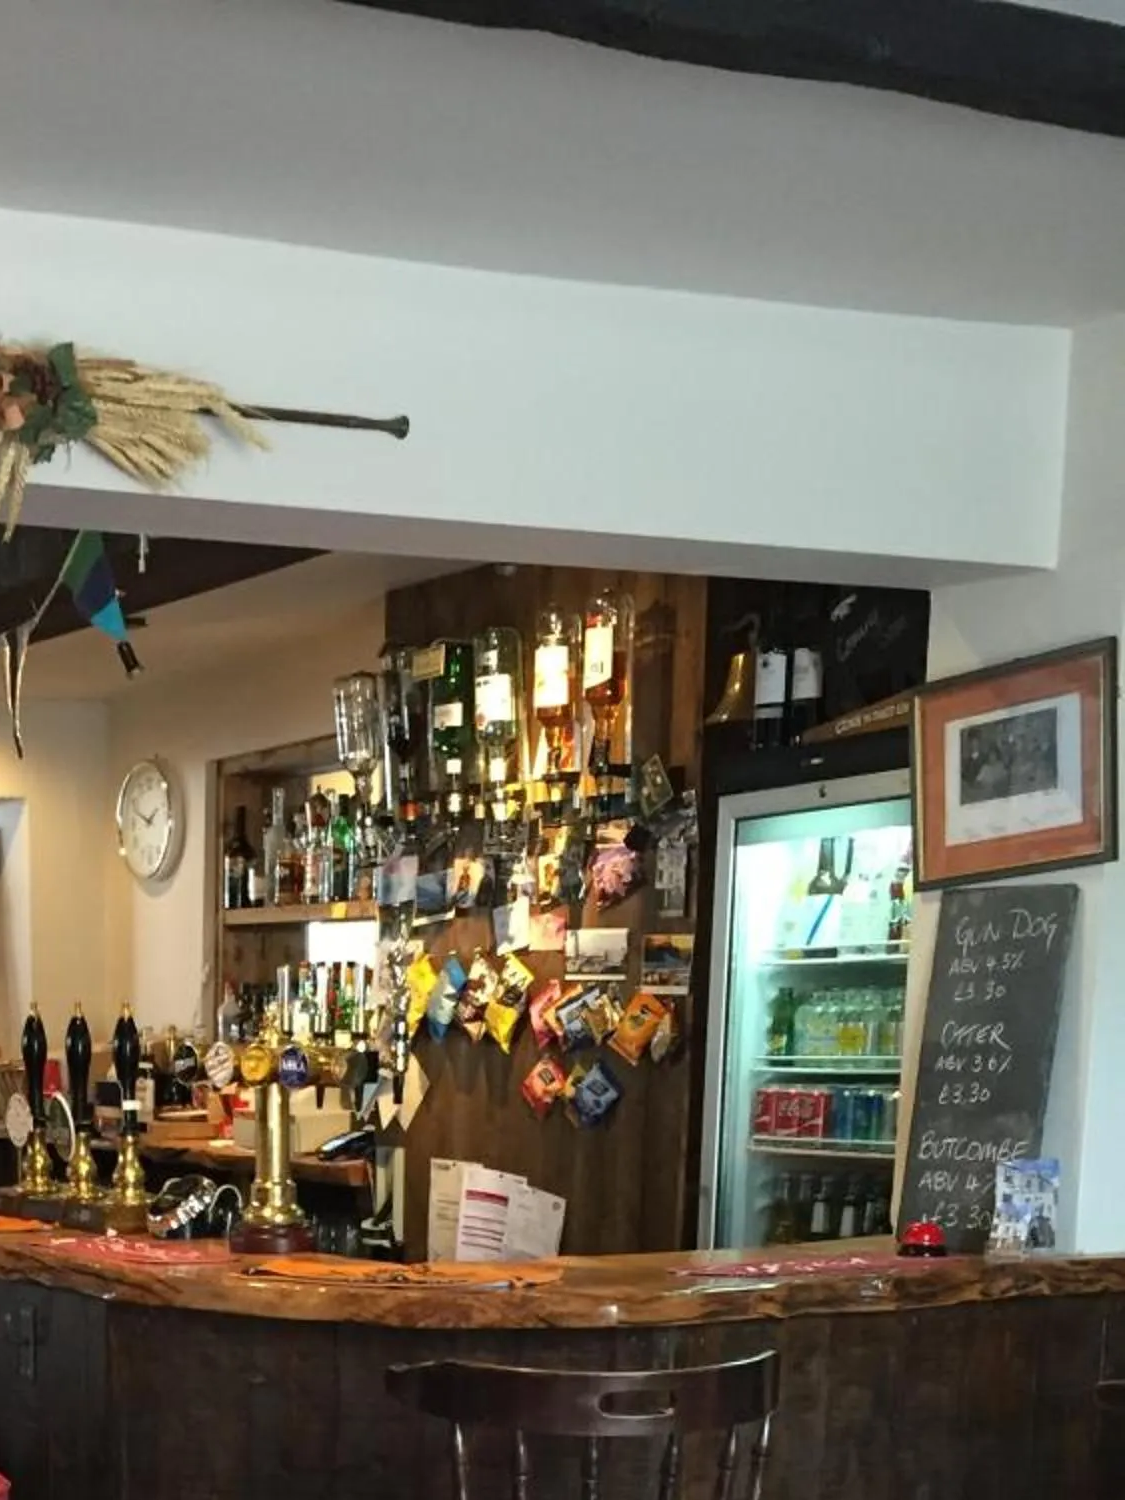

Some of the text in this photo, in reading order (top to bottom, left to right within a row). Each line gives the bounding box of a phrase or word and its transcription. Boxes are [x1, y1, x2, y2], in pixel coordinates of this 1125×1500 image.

[1008, 907, 1058, 951] DOG
[917, 1129, 1030, 1163] BUTCOMBE
[918, 1170, 960, 1193] ABV
